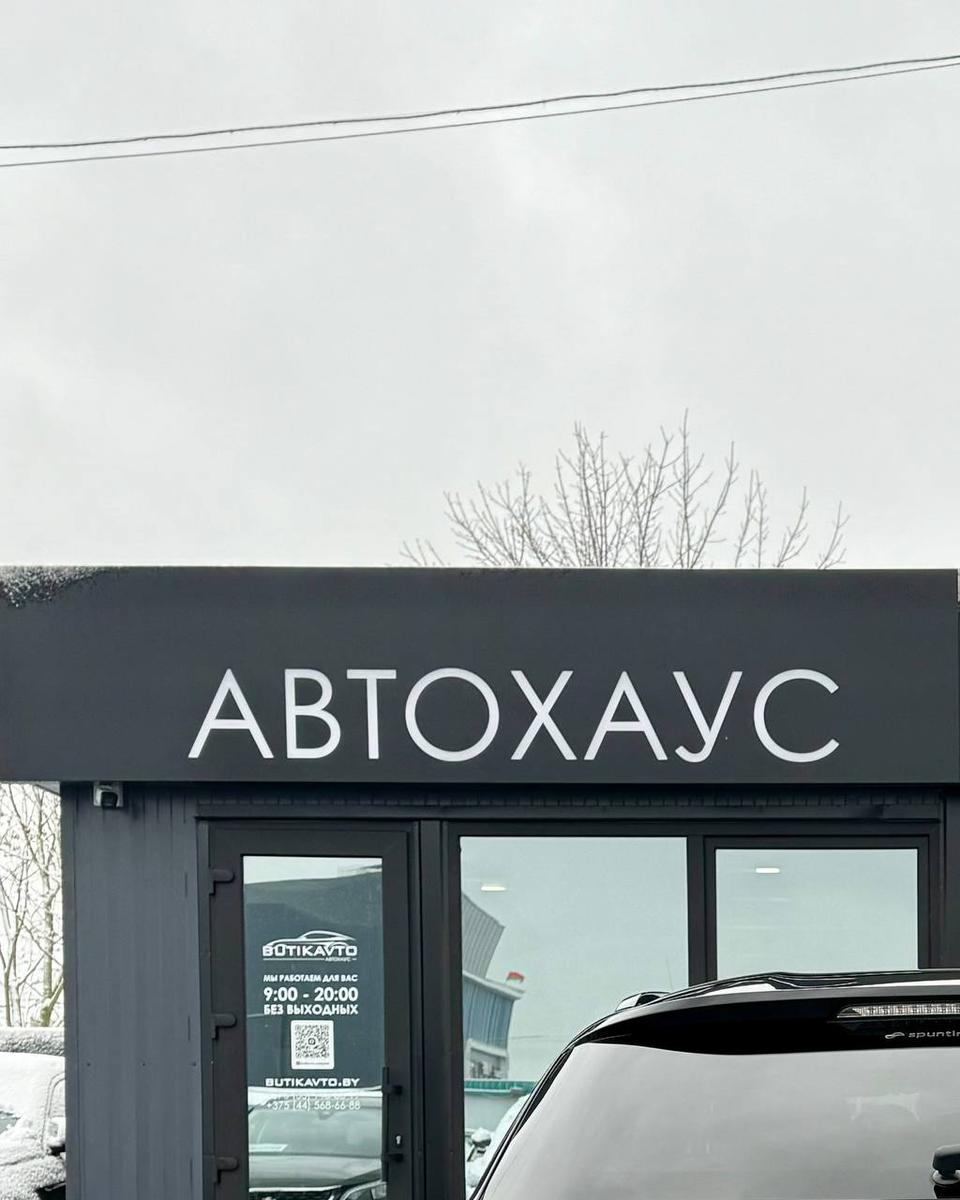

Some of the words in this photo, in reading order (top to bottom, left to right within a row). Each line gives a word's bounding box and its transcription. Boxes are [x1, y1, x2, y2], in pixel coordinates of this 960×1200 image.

[187, 667, 840, 763] АВТОХАУС
[262, 944, 358, 957] BUTIKAVTO
[263, 974, 278, 982] МЫ
[279, 974, 321, 982] РАБОТАЕМ
[322, 974, 340, 982] ДЛЯ
[341, 974, 358, 982] ВАС
[263, 987, 298, 1001] 9:00
[314, 987, 359, 1001] 20:00
[263, 1004, 284, 1015] БЕЗ
[286, 1004, 359, 1016] ВЫХОДНЫХ
[265, 1078, 360, 1087] BUTIKAVTO.BY
